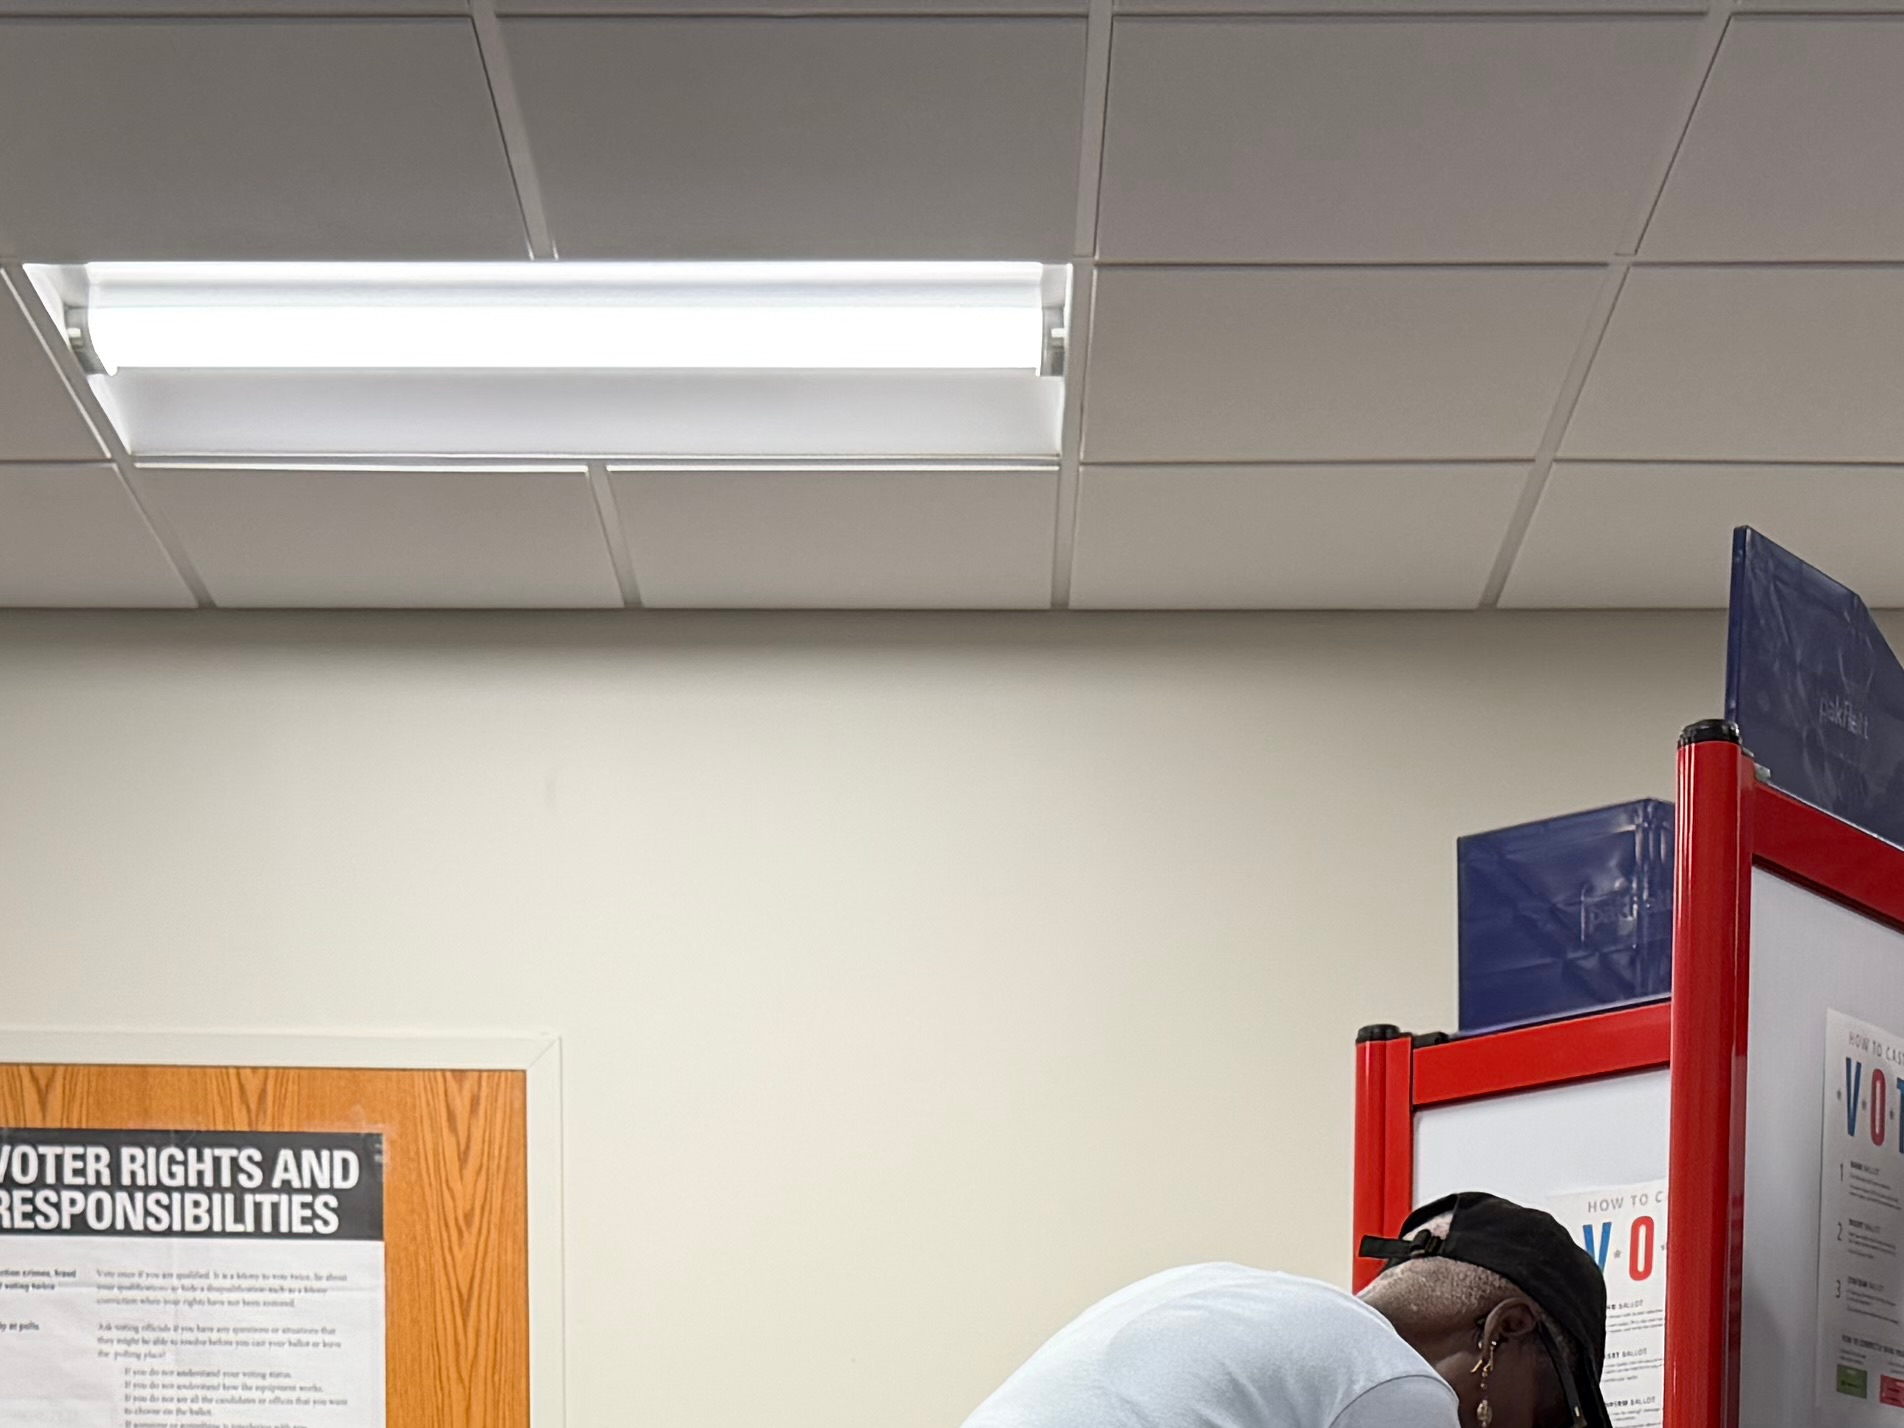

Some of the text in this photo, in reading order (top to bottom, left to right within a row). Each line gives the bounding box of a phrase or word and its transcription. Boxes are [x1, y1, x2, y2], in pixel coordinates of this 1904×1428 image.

[1849, 1032, 1868, 1052] HOW
[1872, 1041, 1882, 1057] TO
[121, 1148, 263, 1188] RIGHTS
[272, 1150, 359, 1190] AND
[1588, 1194, 1648, 1212] HOW TO
